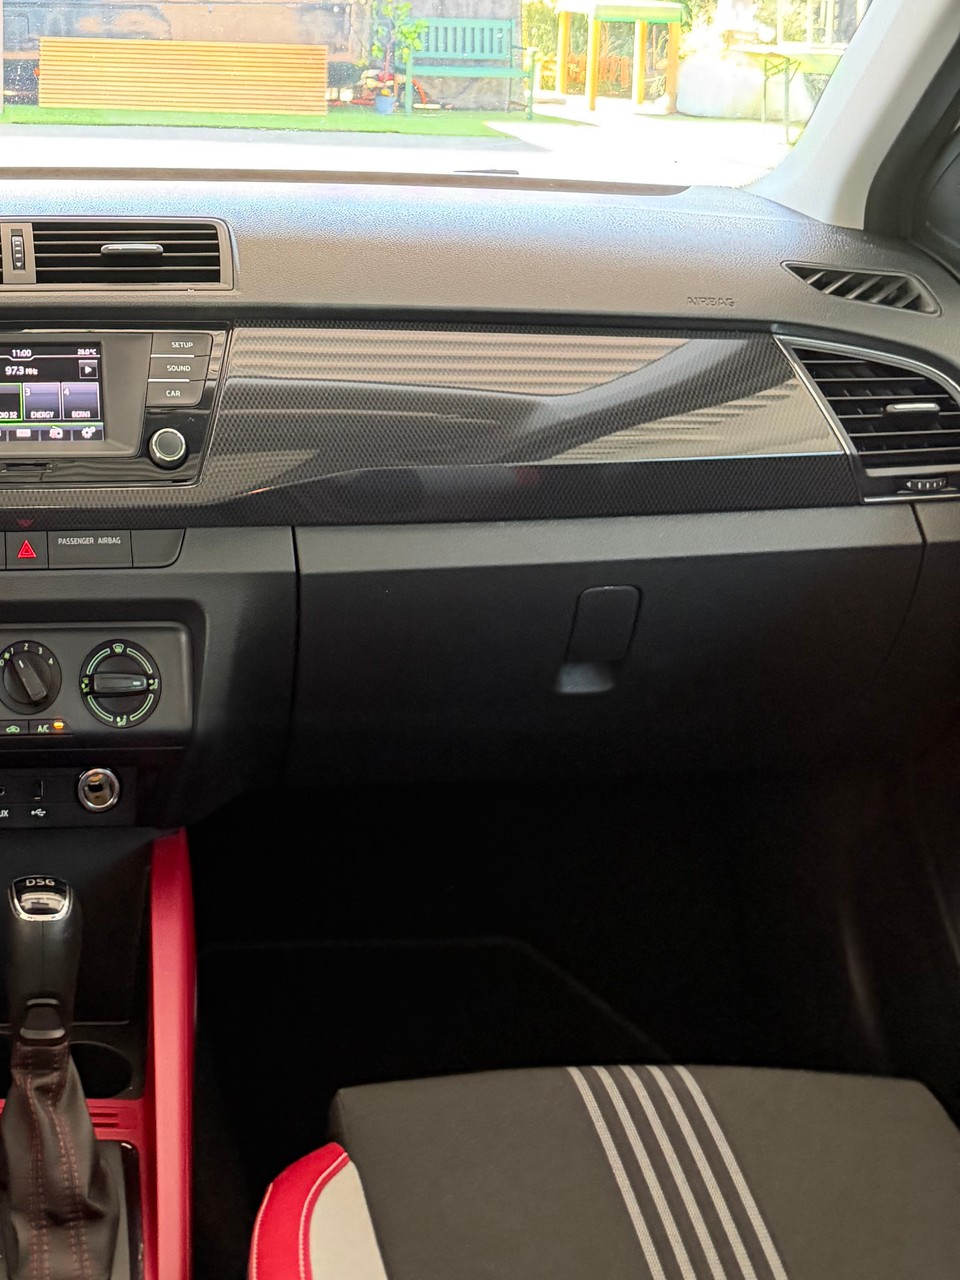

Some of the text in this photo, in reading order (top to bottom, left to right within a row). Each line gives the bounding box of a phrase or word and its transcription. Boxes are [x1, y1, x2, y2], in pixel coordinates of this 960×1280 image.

[687, 296, 735, 307] AIRBAG
[11, 349, 32, 357] 11:00
[4, 365, 25, 376] 97.3
[166, 364, 191, 372] SOUND
[25, 387, 31, 396] 3
[63, 387, 70, 396] 4
[165, 389, 181, 397] CAR
[57, 536, 122, 545] PASSENGER AIRBAG
[23, 642, 29, 651] 2
[38, 646, 43, 655] 3
[48, 657, 54, 665] 4
[37, 724, 50, 733] A/C
[25, 878, 56, 887] DSG
